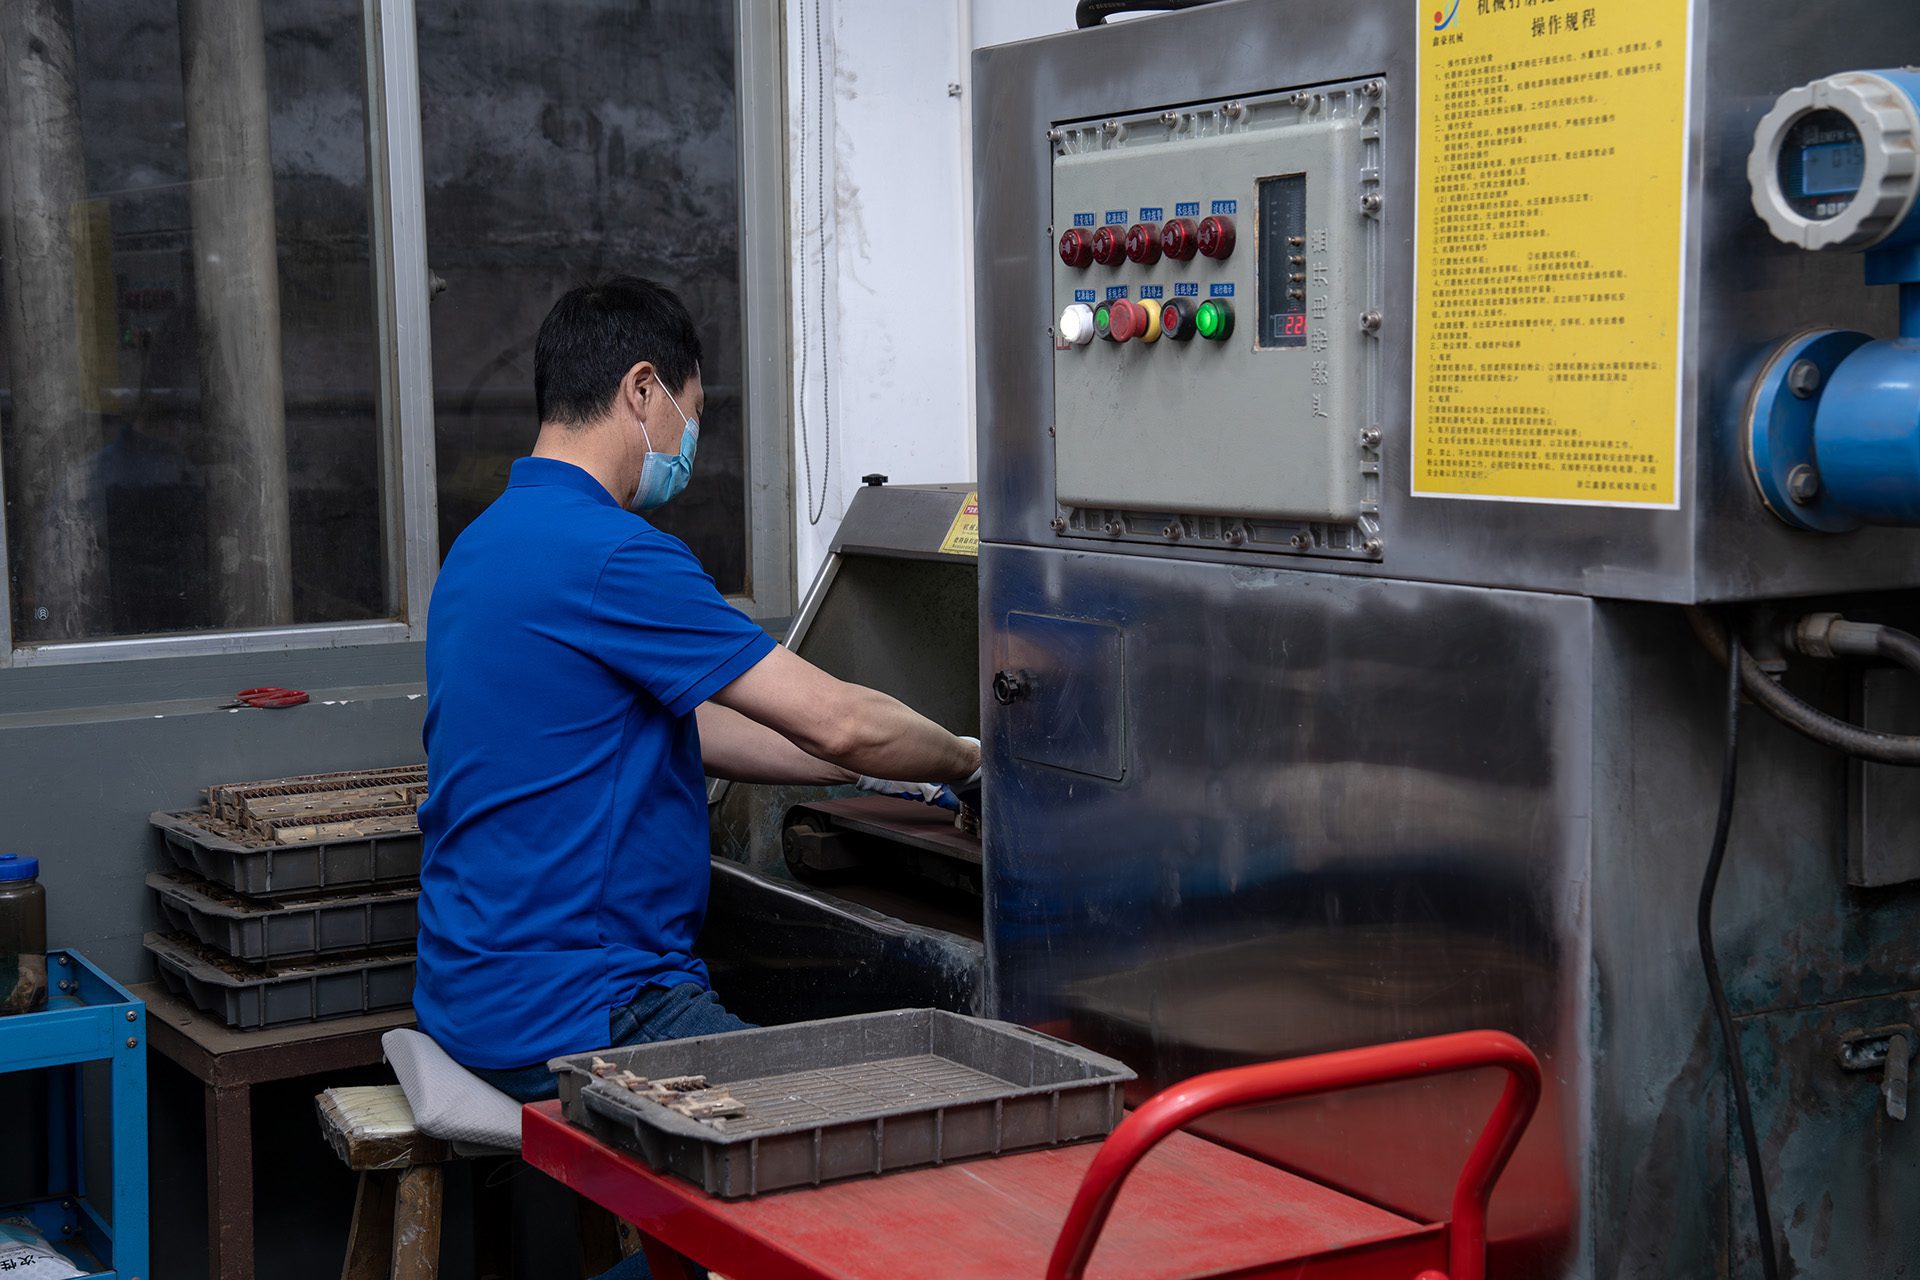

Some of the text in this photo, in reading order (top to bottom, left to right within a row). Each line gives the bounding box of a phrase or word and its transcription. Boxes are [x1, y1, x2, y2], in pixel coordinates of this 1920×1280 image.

[1531, 8, 1597, 38] 操作规程
[1285, 315, 1307, 335] 22
[1311, 227, 1329, 419] 严禁带电开盖
[0, 1255, 54, 1271] 一次性
